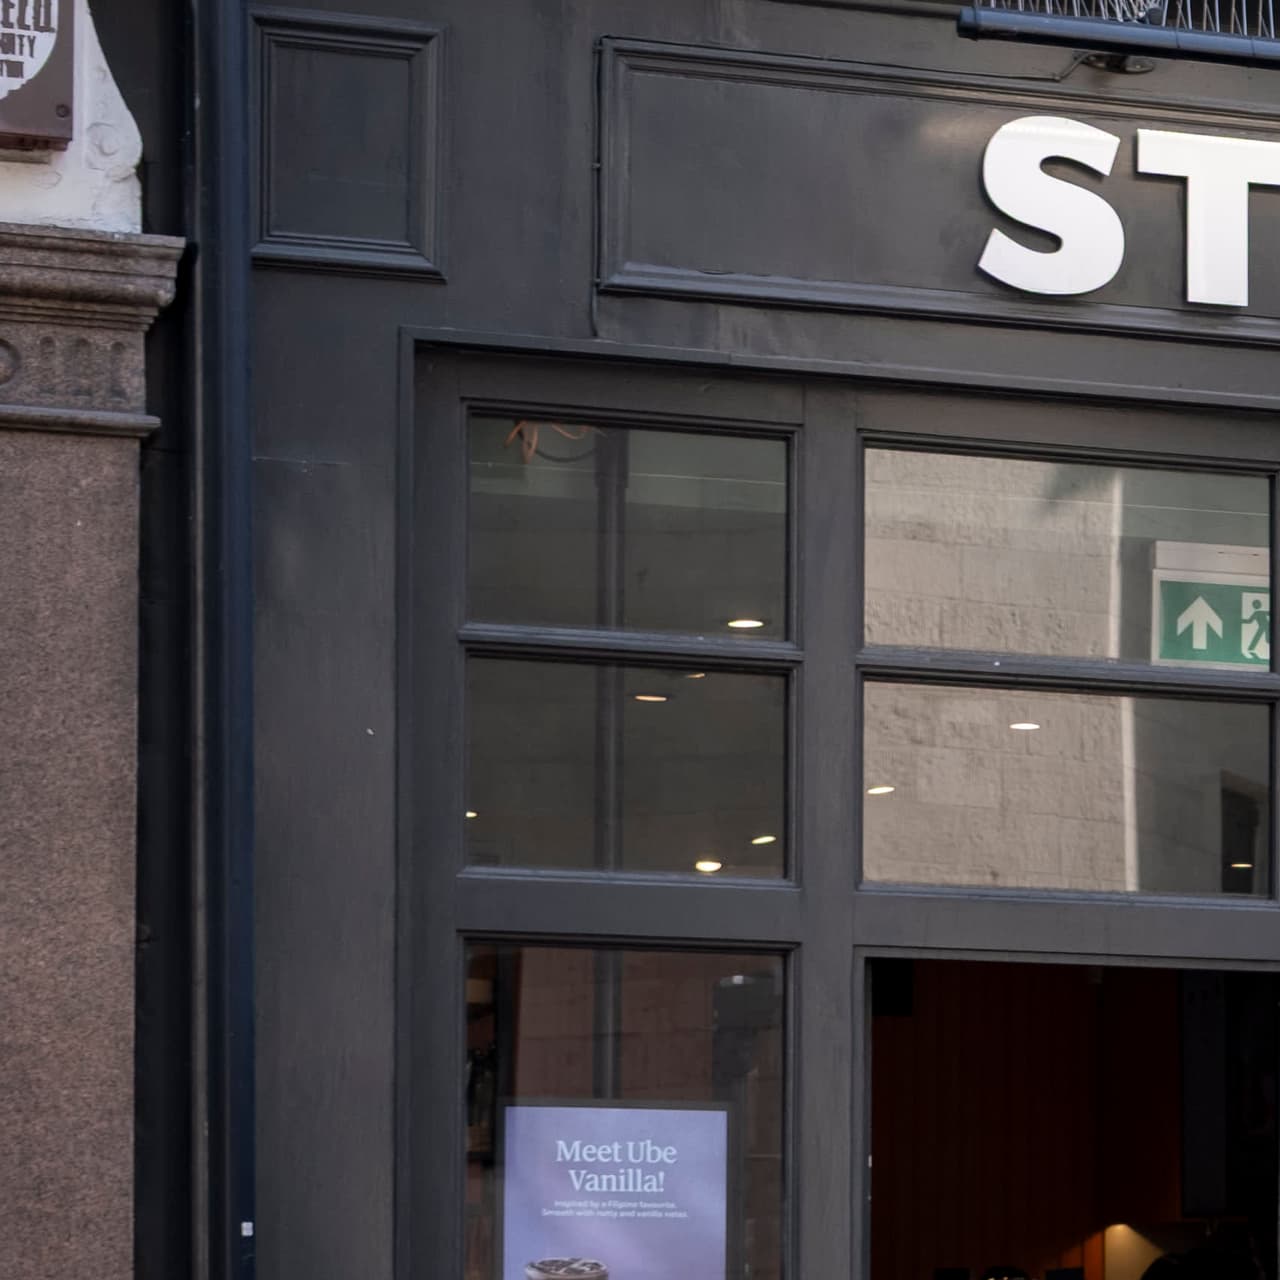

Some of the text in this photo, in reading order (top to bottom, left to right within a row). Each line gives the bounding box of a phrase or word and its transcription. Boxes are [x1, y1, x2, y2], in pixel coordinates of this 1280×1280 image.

[555, 1139, 678, 1164] Meet Ube
[568, 1168, 665, 1193] Vanilla!
